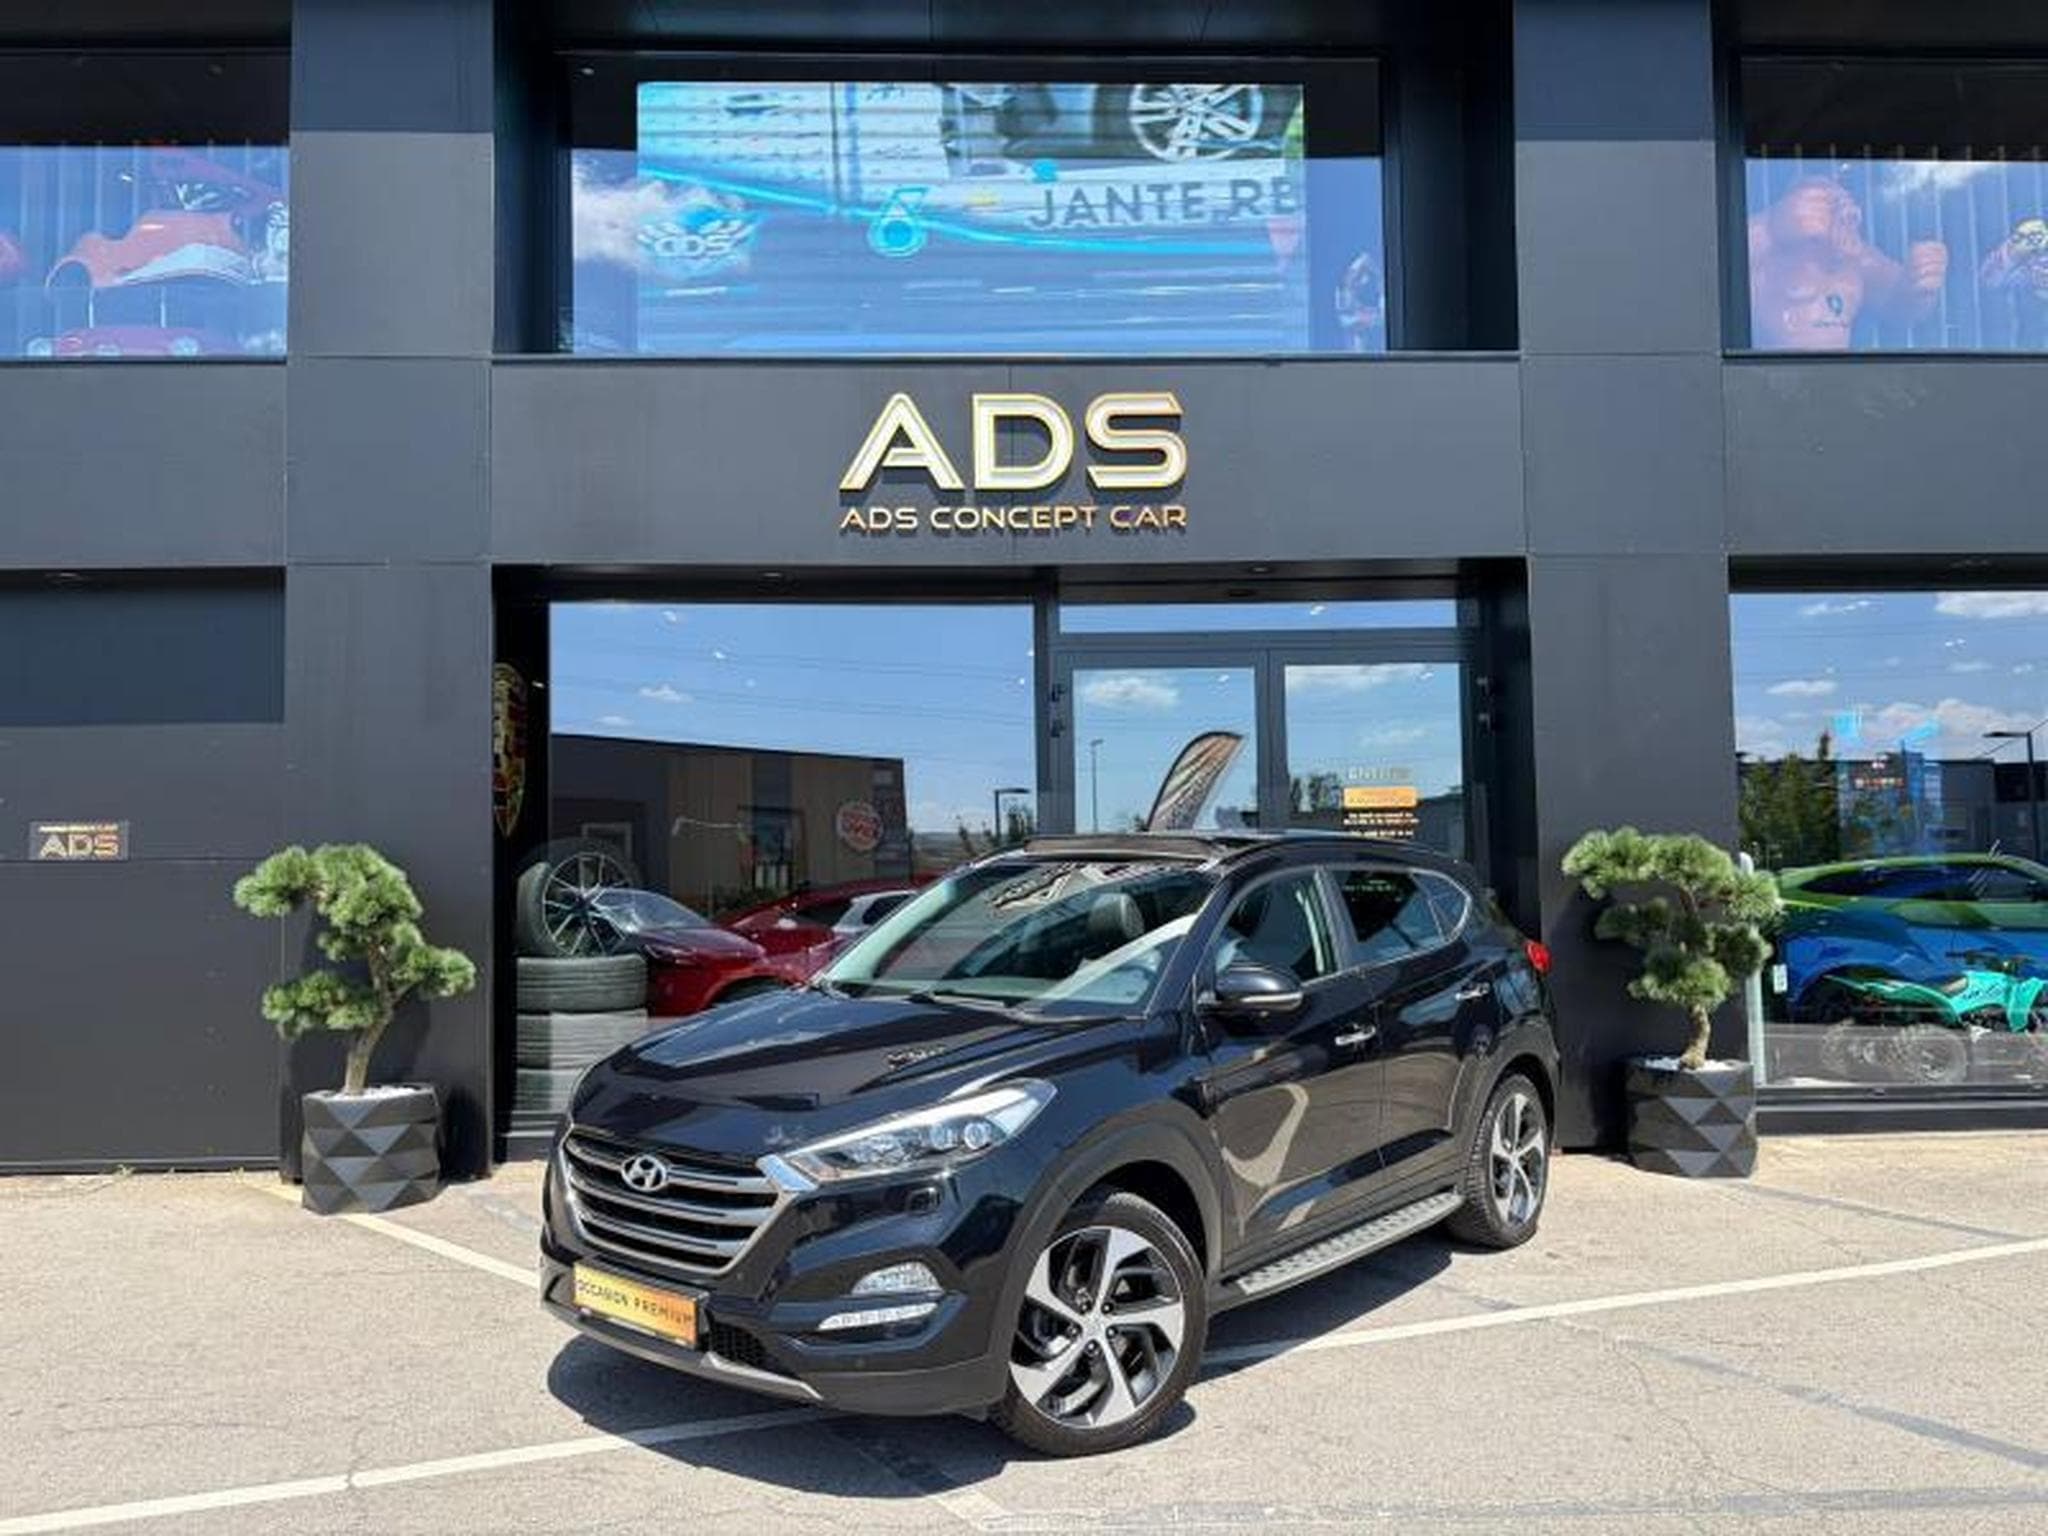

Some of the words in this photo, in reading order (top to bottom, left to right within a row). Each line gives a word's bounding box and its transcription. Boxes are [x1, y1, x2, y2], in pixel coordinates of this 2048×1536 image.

[1028, 182, 1205, 228] JANTE
[839, 392, 1188, 491] ADS
[840, 506, 918, 530] ADS
[930, 506, 1098, 530] CONCEPT
[1109, 505, 1188, 528] CAR
[39, 832, 119, 859] ADS
